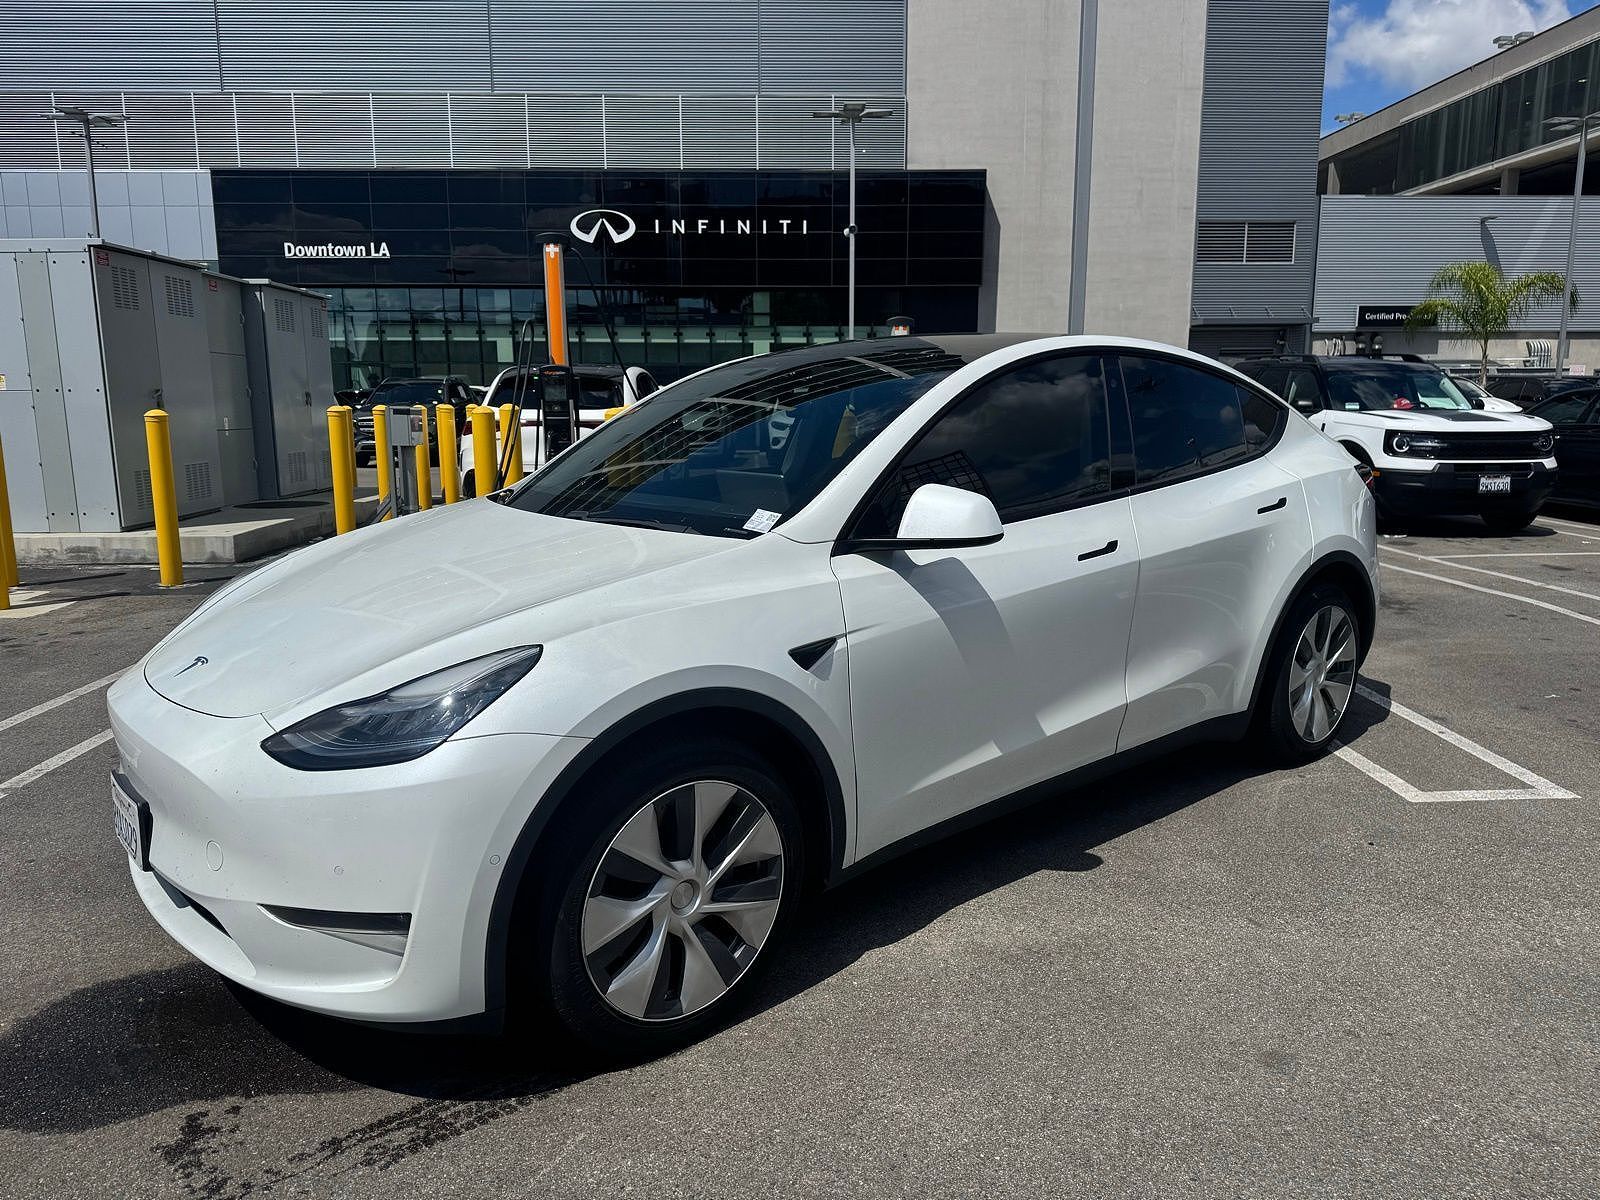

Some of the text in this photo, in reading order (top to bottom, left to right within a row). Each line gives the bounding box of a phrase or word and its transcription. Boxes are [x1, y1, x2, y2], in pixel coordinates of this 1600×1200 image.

[654, 219, 808, 235] INFINITI
[283, 241, 391, 258] Downtown LA
[1365, 312, 1394, 320] Certified
